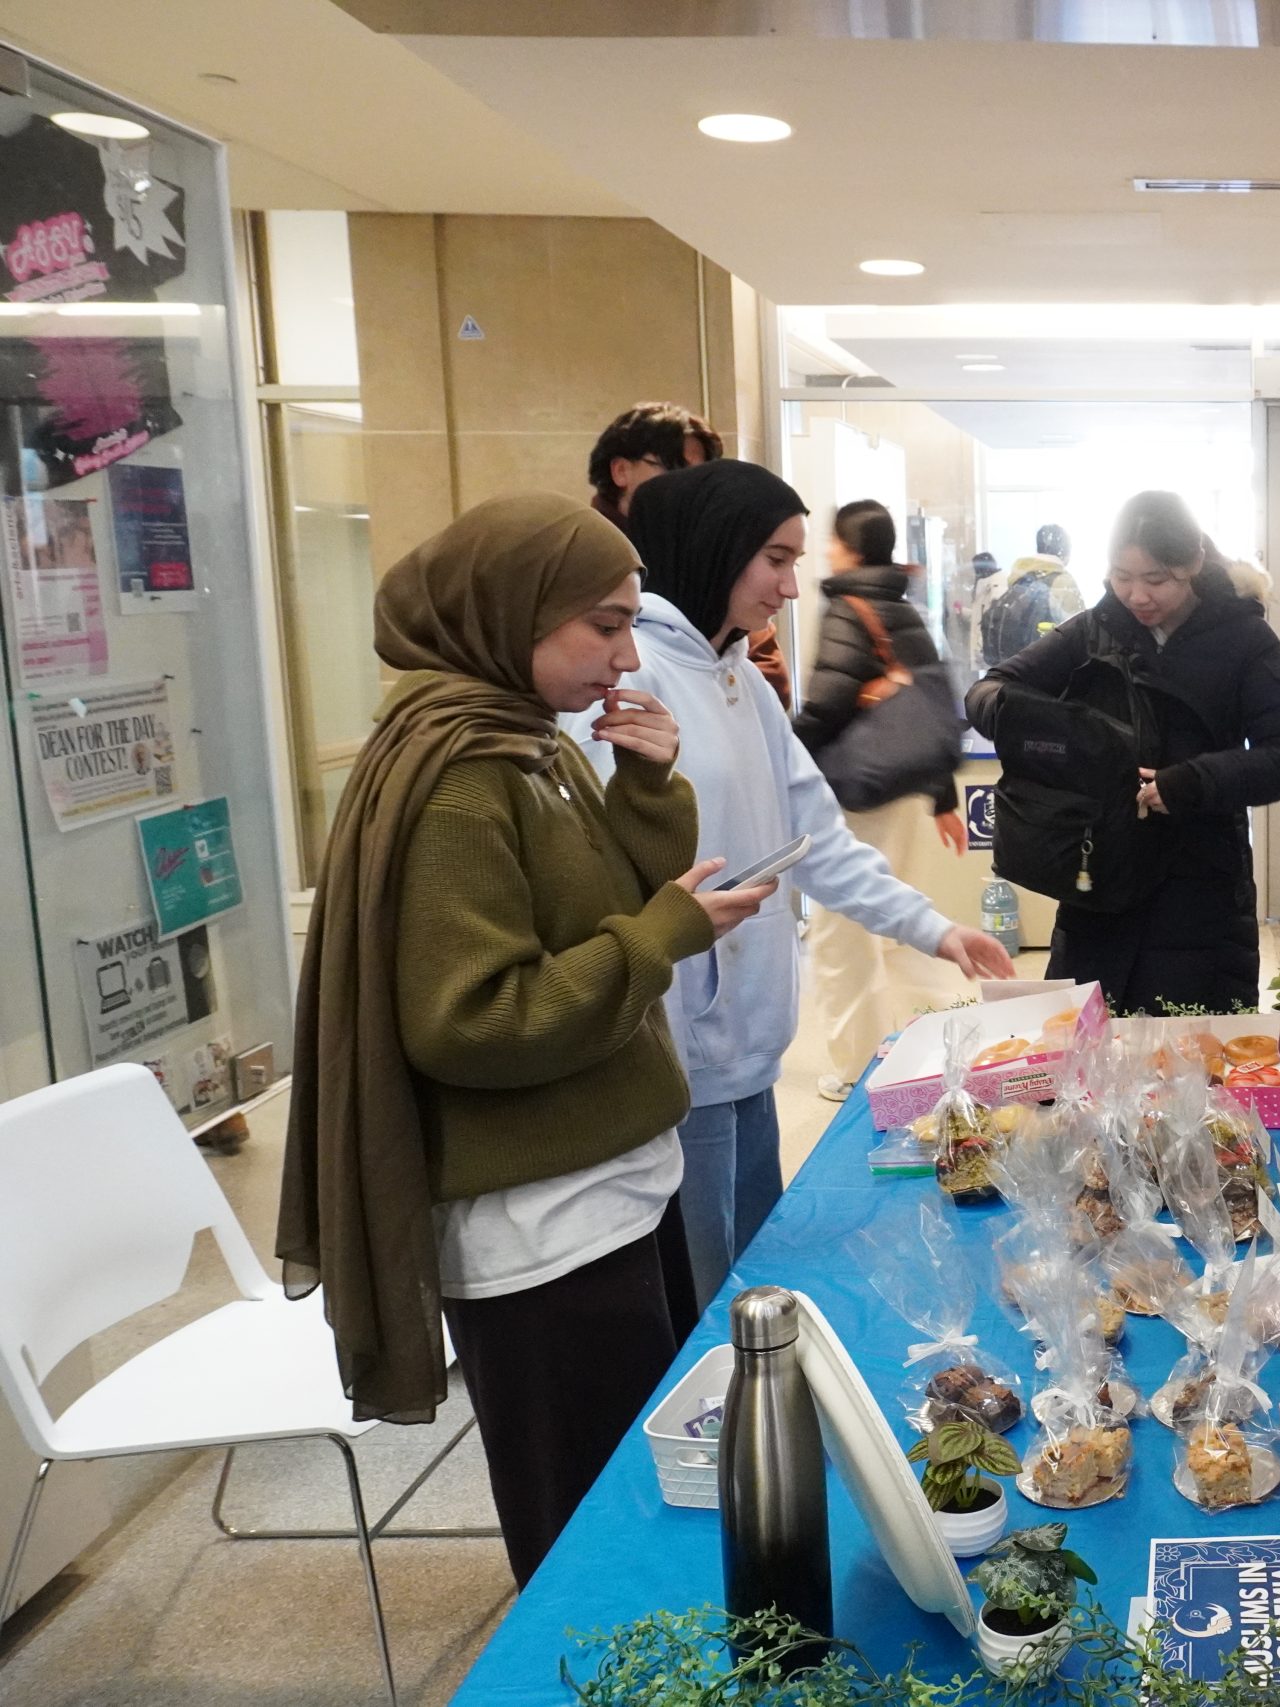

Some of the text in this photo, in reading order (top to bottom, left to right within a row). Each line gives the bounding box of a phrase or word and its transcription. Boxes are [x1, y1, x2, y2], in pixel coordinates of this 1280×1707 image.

[37, 713, 157, 760] DEAN FOR THE DAY
[65, 747, 129, 782] CONTEST!
[97, 926, 153, 959] WATCH
[1238, 1562, 1268, 1583] IN
